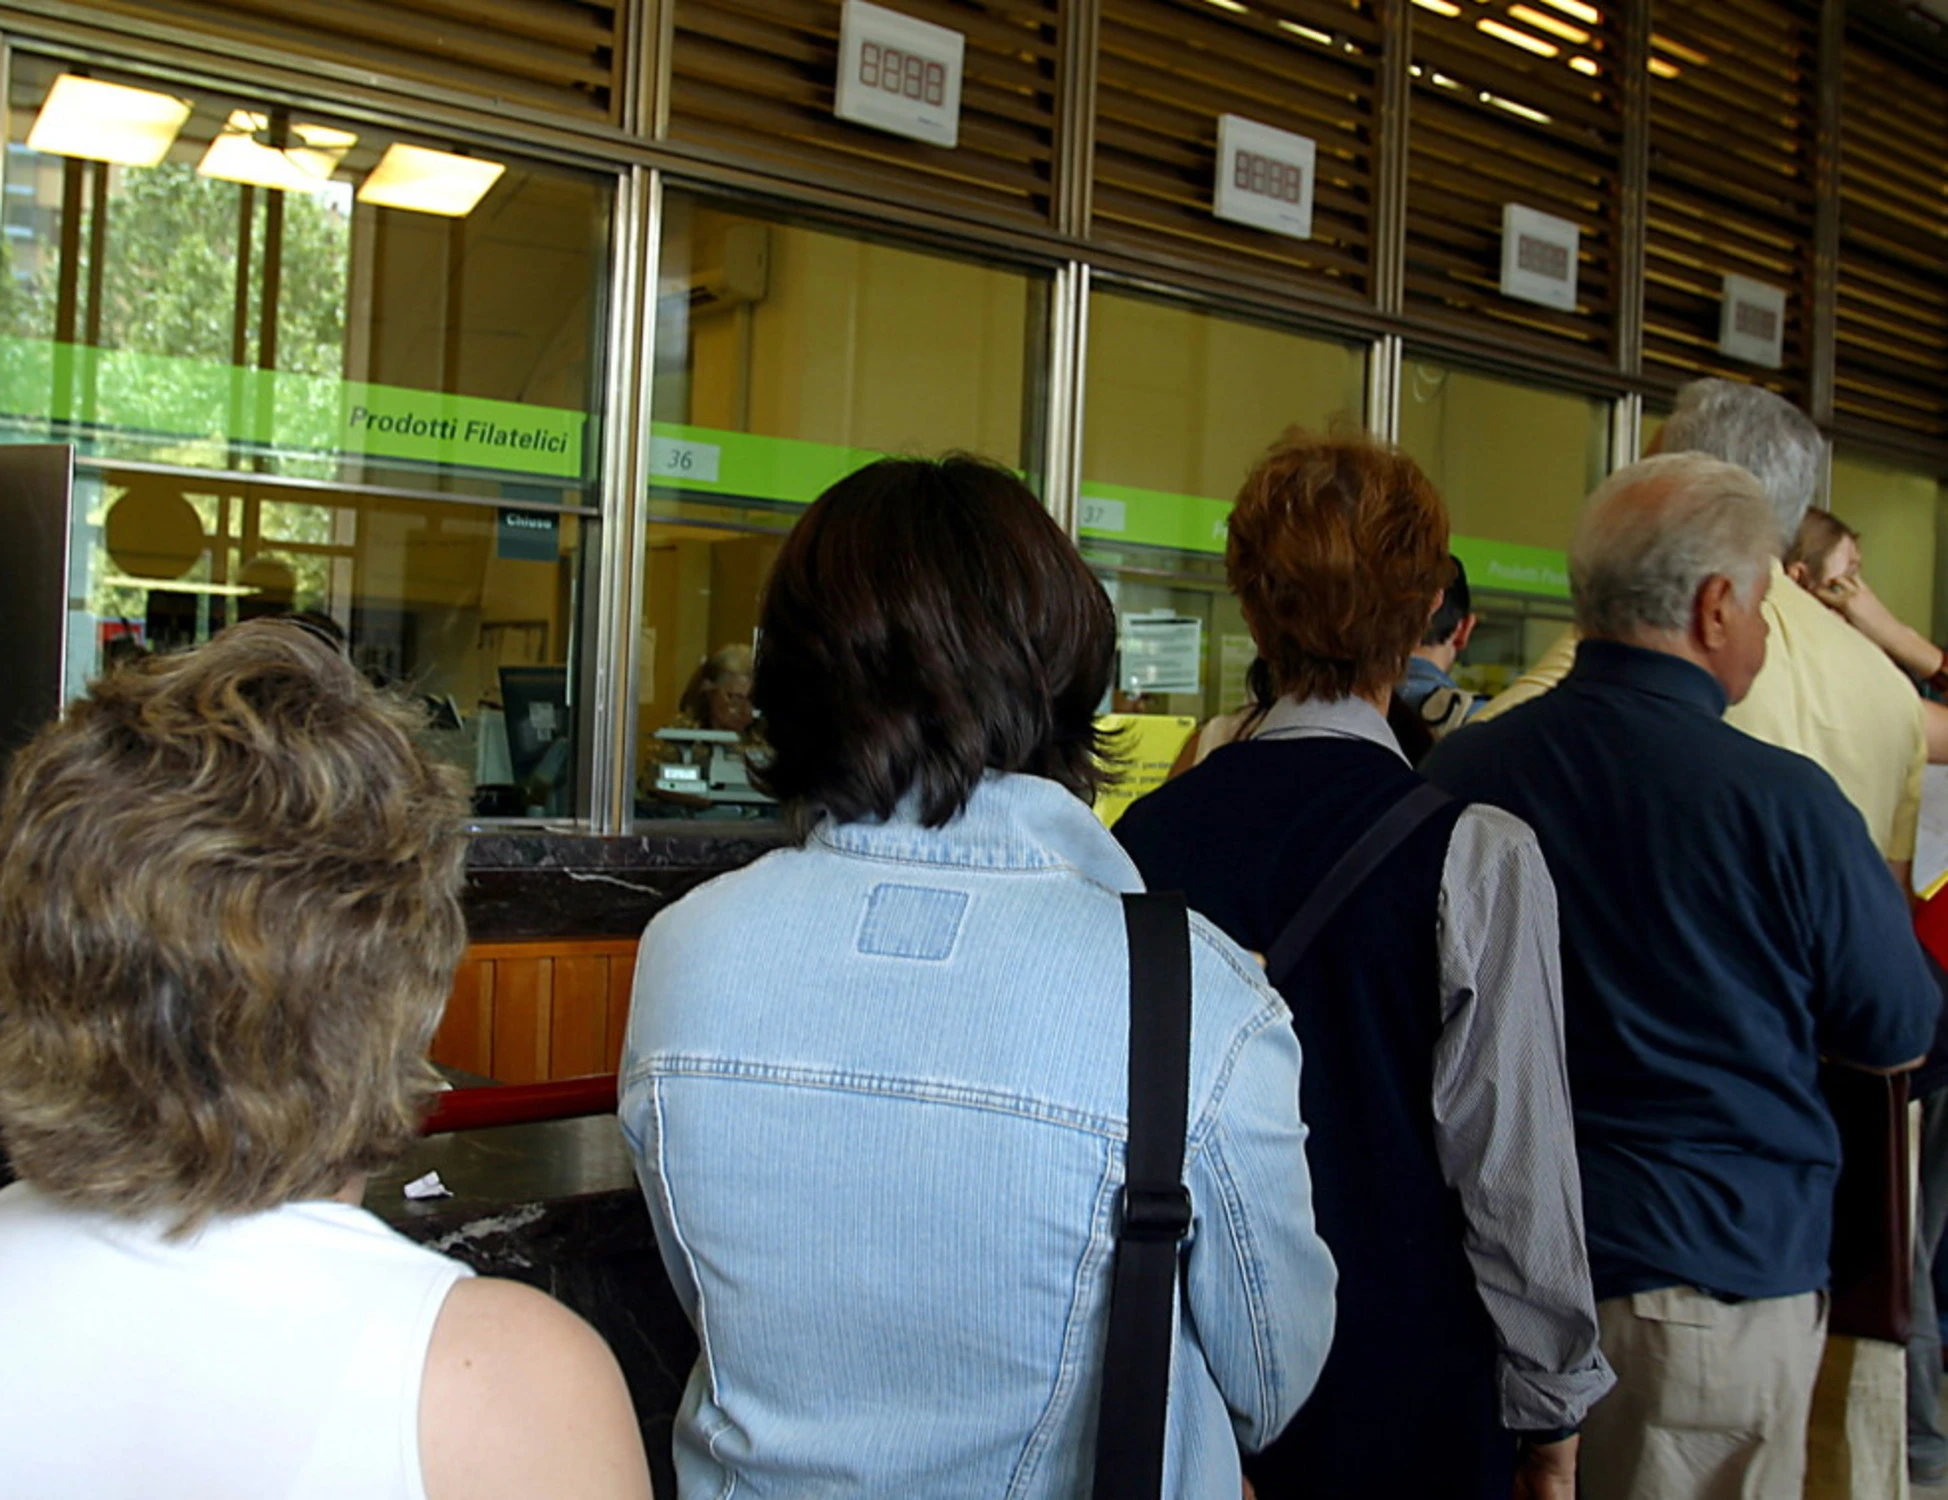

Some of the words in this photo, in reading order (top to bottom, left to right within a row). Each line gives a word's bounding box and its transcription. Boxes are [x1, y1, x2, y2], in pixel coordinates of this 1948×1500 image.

[349, 406, 459, 440] Prodotti
[464, 420, 569, 454] Filatelici
[667, 448, 693, 470] 36
[1084, 505, 1105, 523] 37
